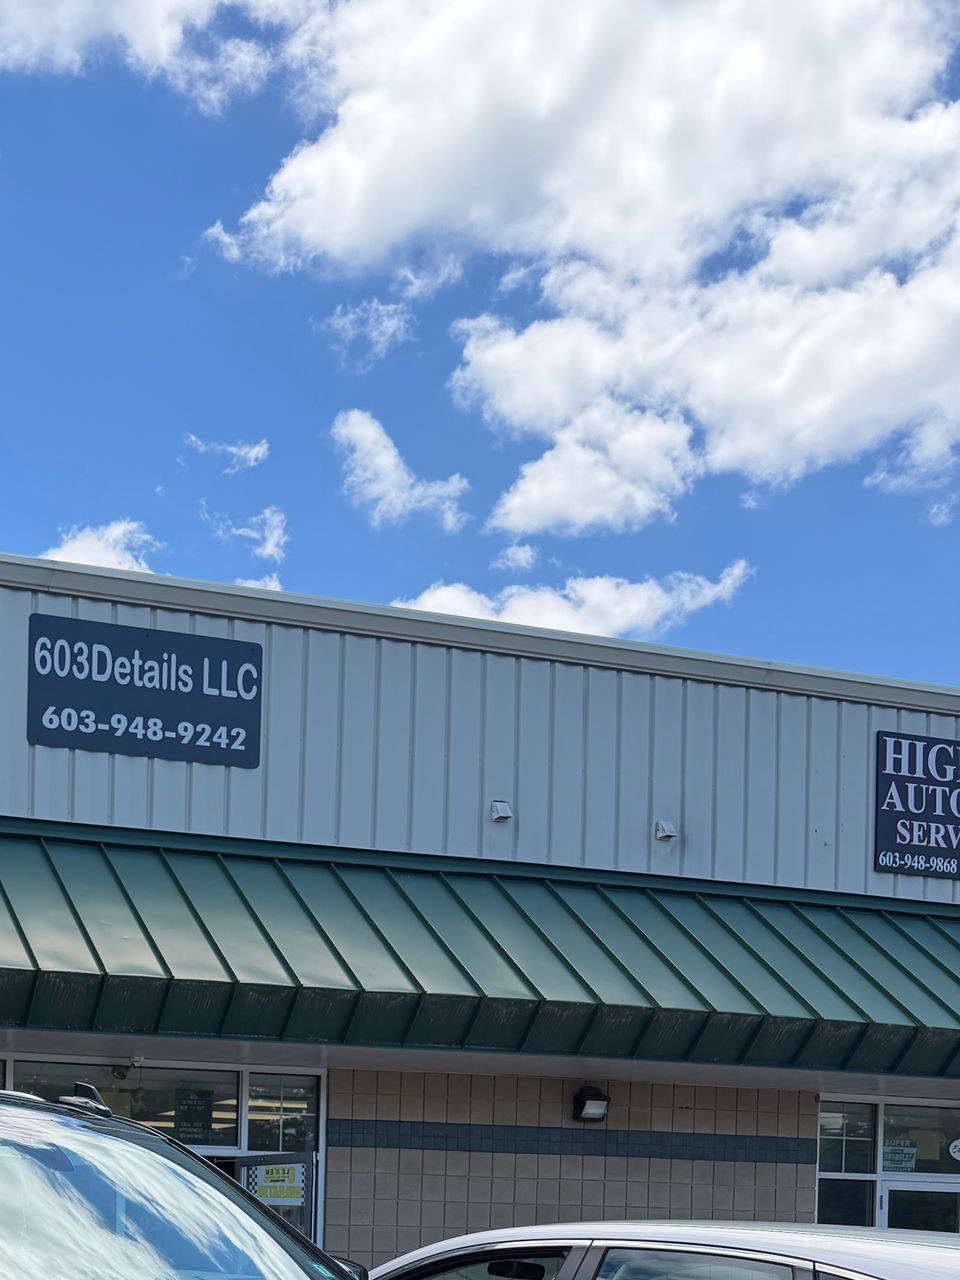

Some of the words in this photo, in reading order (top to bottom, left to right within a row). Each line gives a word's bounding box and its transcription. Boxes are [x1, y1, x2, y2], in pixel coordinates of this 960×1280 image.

[34, 636, 193, 693] 603Details
[203, 657, 258, 700] LLC
[42, 706, 247, 750] 603-948-9242
[882, 736, 960, 782] HIG
[878, 850, 958, 874] 603-948-9868
